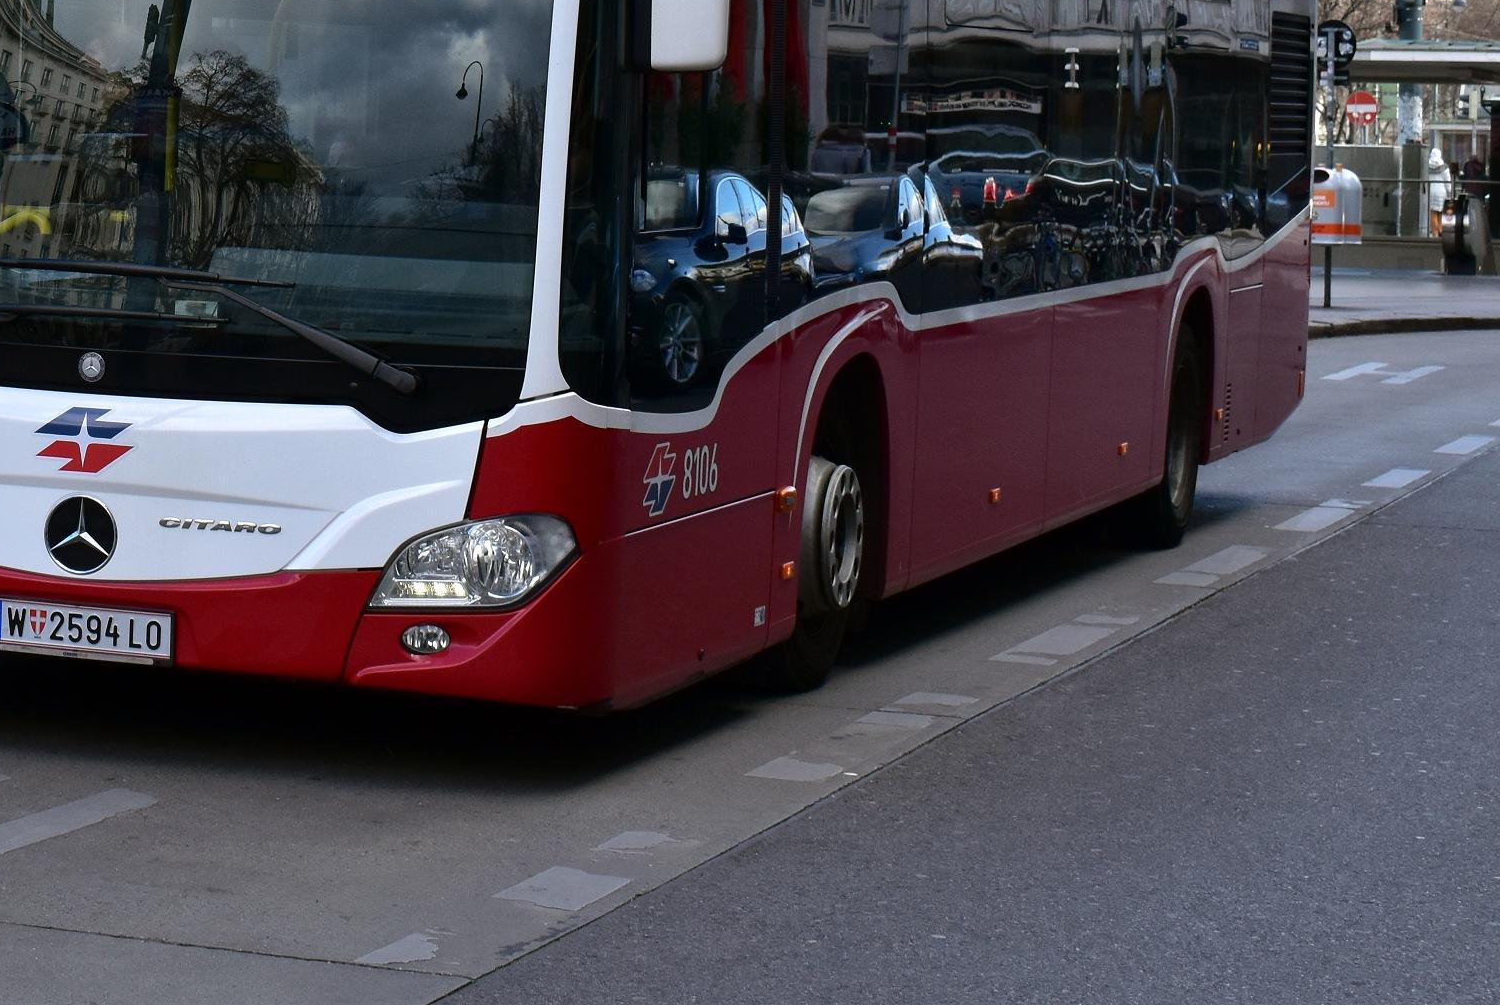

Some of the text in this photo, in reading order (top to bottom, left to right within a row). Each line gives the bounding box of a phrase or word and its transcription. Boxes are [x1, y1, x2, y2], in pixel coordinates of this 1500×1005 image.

[683, 443, 718, 499] 8106
[159, 516, 282, 535] CITARO
[8, 607, 27, 638] W
[50, 611, 120, 647] 2594
